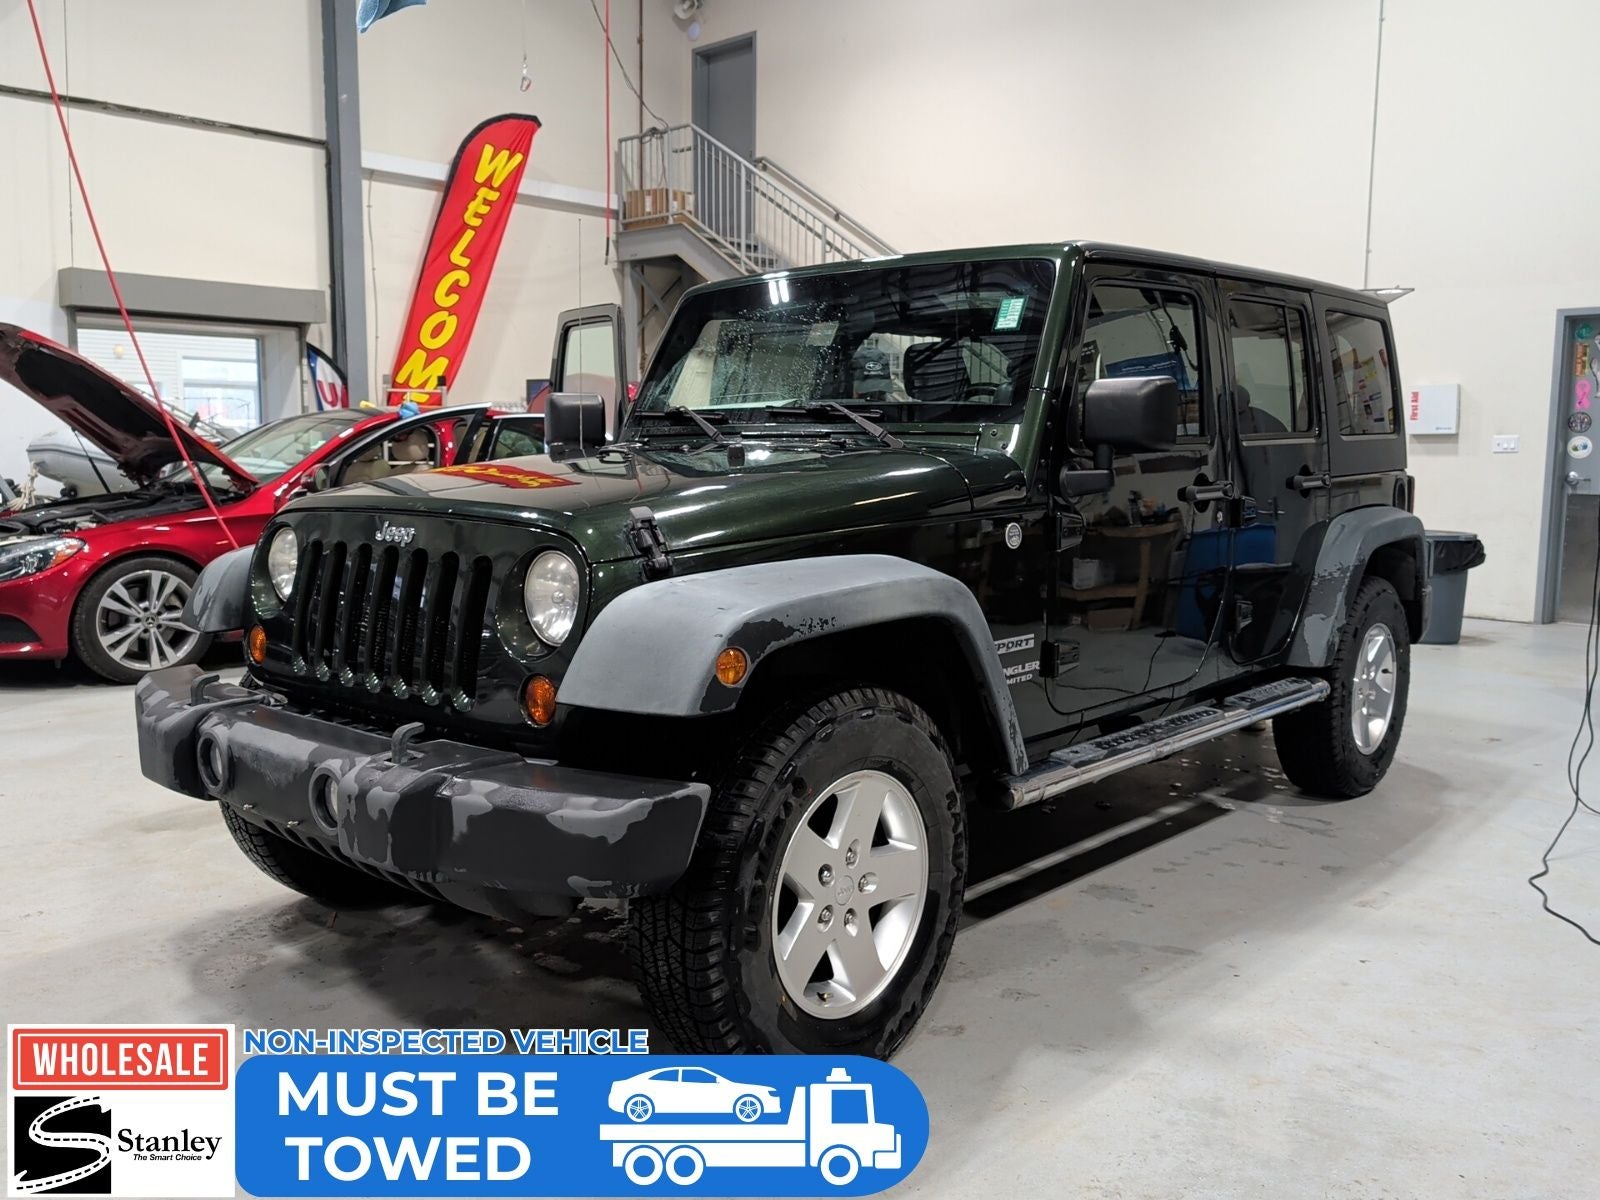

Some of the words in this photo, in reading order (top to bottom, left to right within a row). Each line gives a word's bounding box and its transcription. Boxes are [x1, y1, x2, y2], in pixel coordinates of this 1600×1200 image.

[1410, 391, 1419, 403] Aid
[1410, 404, 1419, 421] First
[375, 520, 416, 547] Jeep
[994, 638, 1034, 651] PORT
